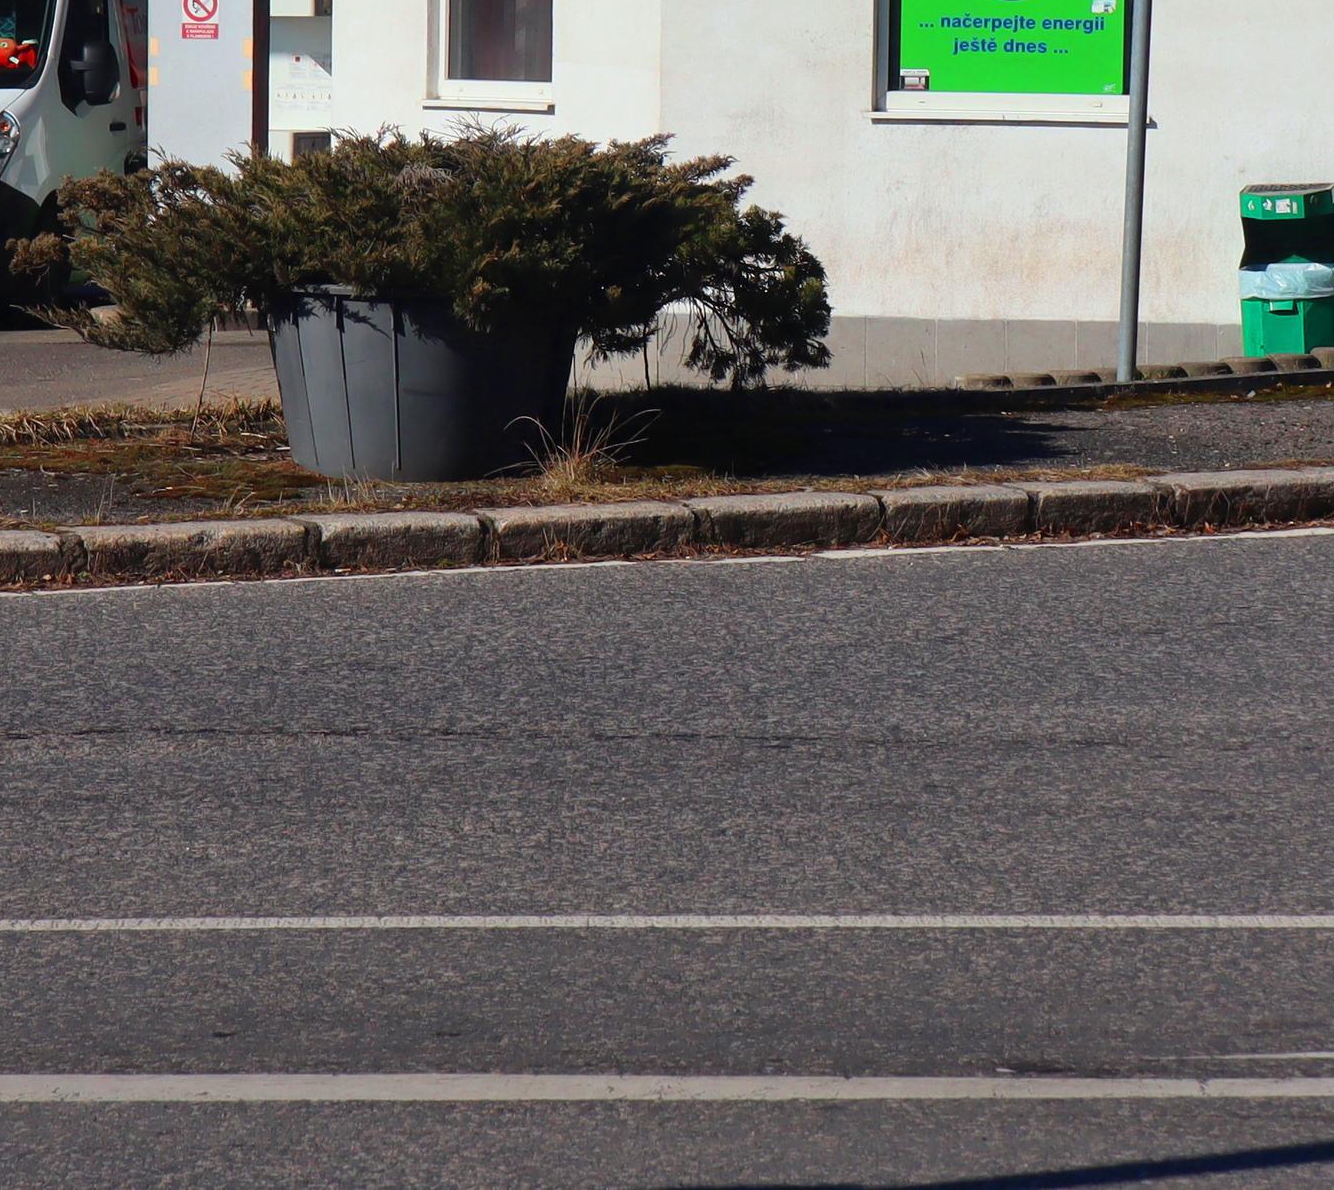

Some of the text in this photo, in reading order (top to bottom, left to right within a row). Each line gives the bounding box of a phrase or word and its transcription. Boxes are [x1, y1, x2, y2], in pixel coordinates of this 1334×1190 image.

[940, 13, 1036, 33] načerpejte
[1041, 16, 1105, 34] energii
[953, 36, 998, 55] ještě
[1003, 39, 1047, 53] dnes
